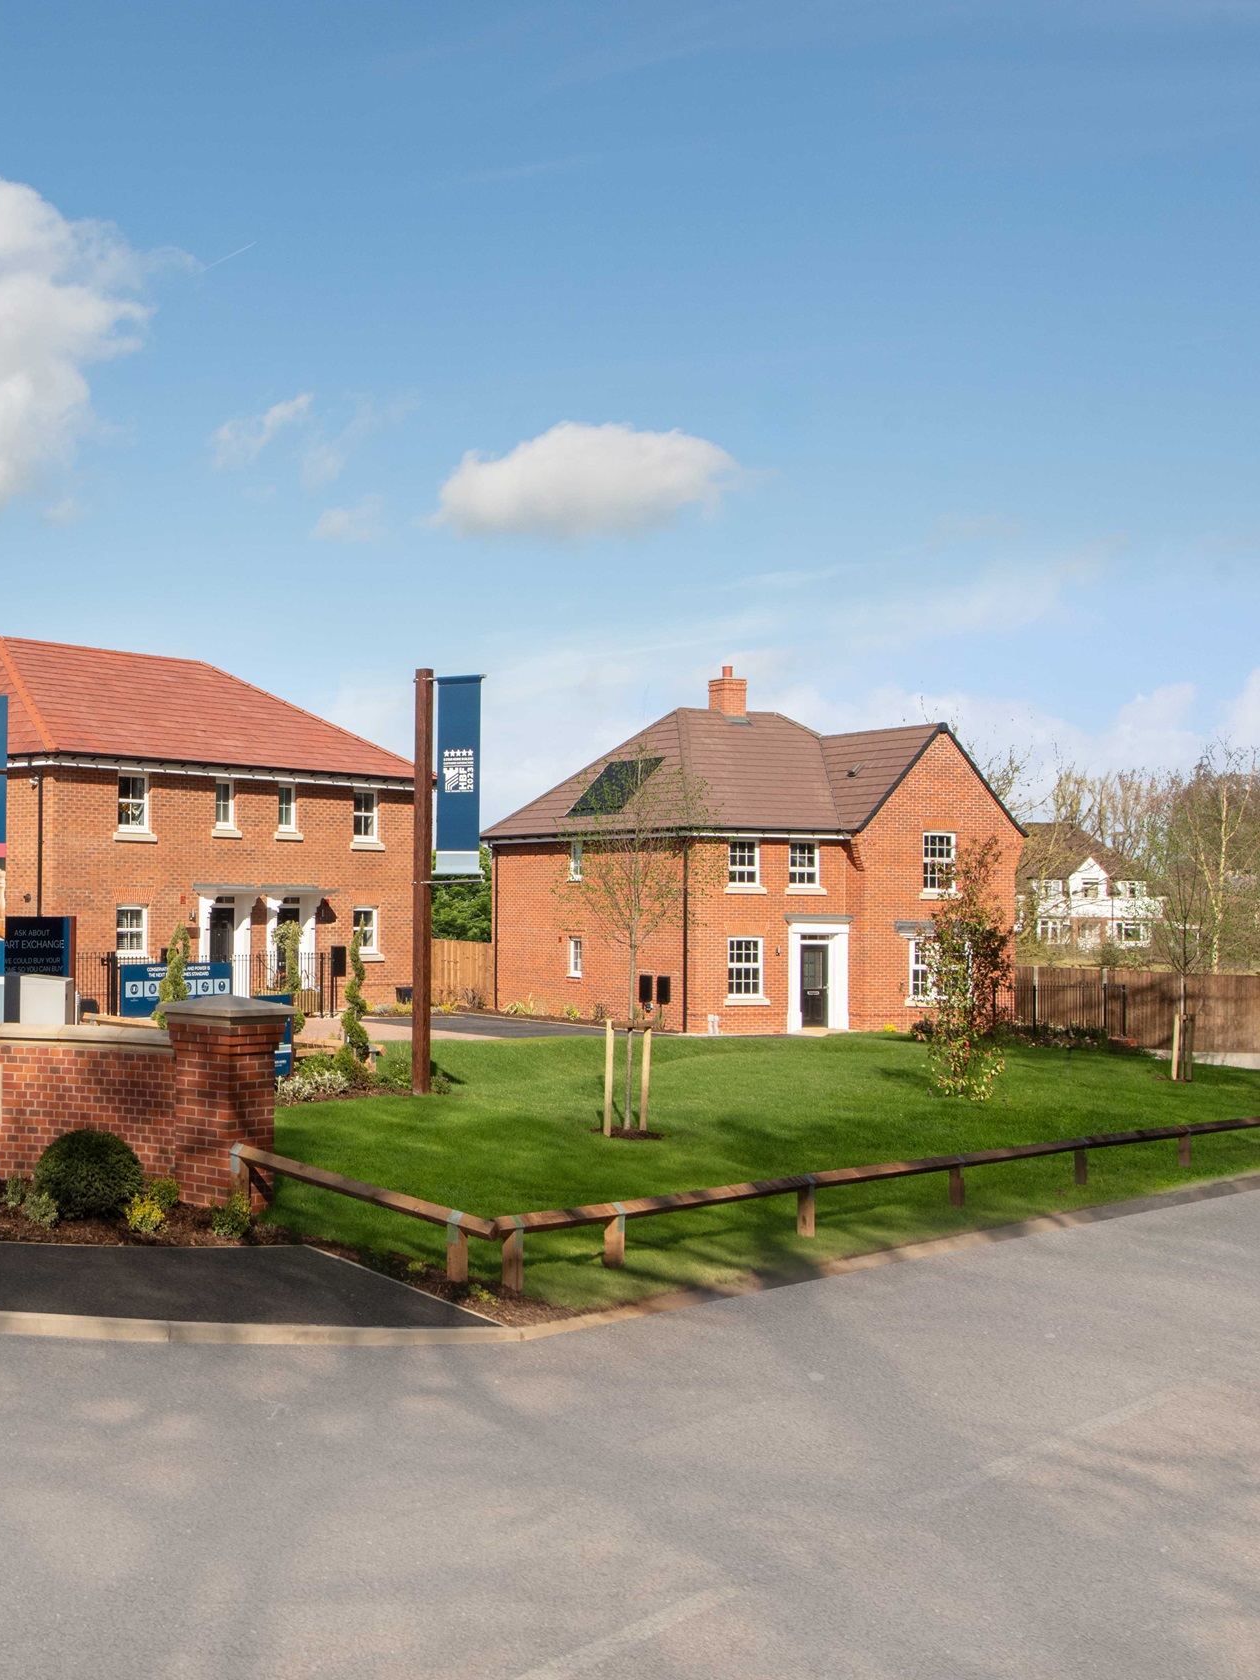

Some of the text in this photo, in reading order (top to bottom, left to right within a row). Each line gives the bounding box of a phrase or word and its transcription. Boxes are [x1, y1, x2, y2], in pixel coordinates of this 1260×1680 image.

[459, 767, 467, 790] HBF
[5, 940, 64, 948] ART EXCHANGE
